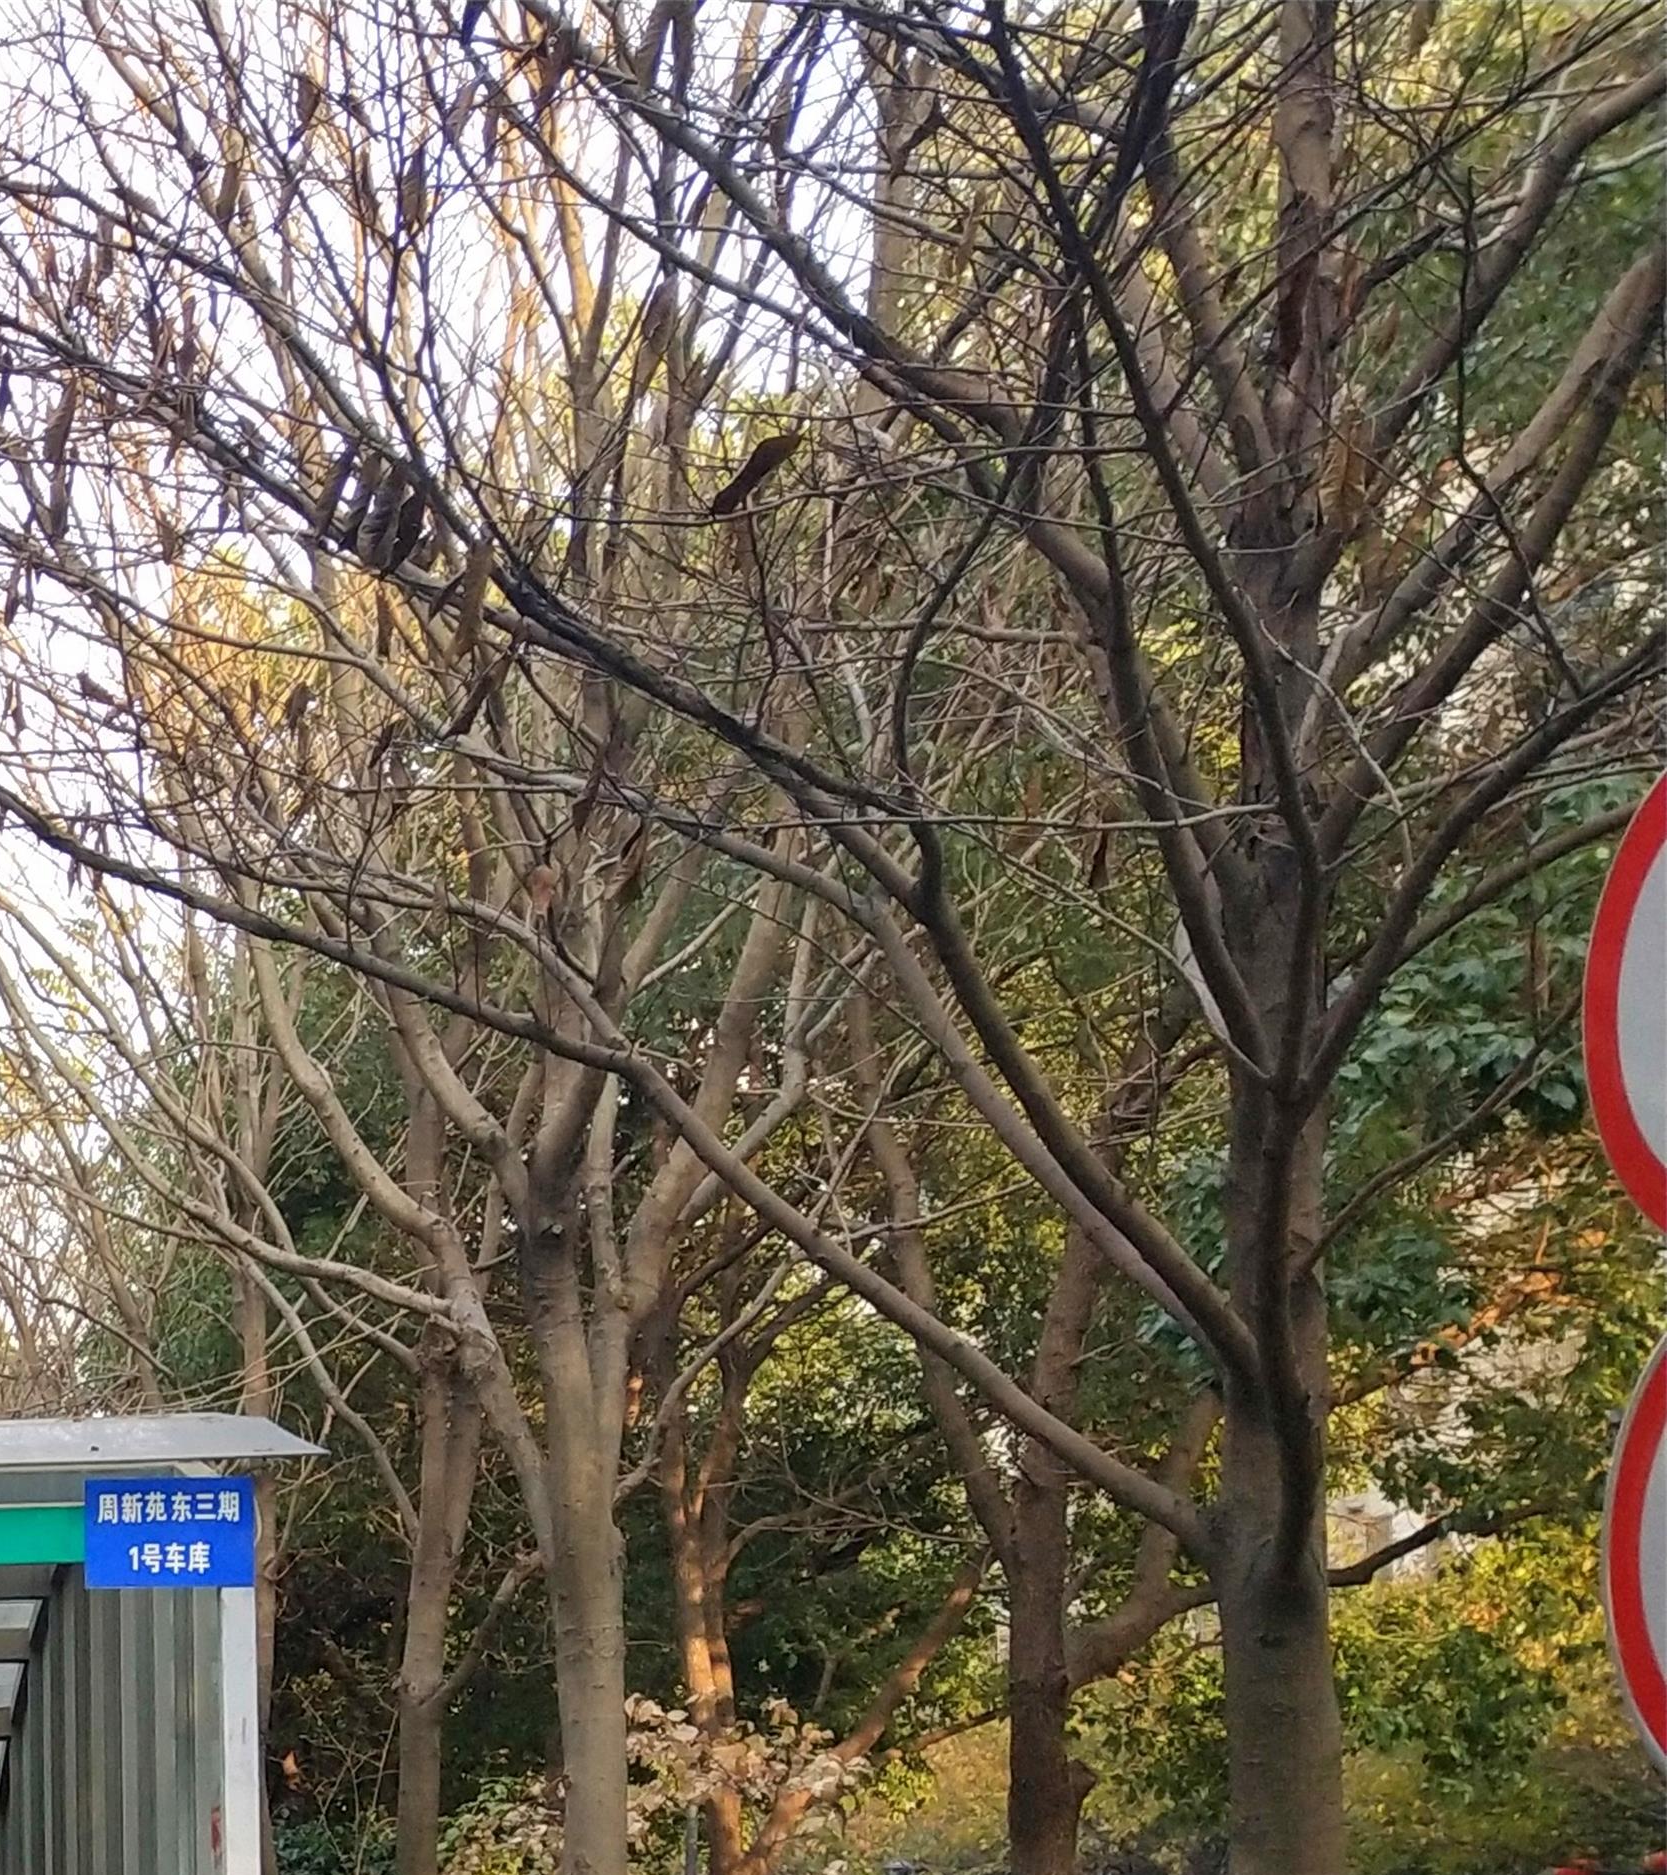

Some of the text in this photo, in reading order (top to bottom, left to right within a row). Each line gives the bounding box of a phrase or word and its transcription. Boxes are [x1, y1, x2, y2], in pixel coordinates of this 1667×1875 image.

[97, 1490, 240, 1524] 周新苑东三期
[129, 1542, 210, 1574] 1号车库
